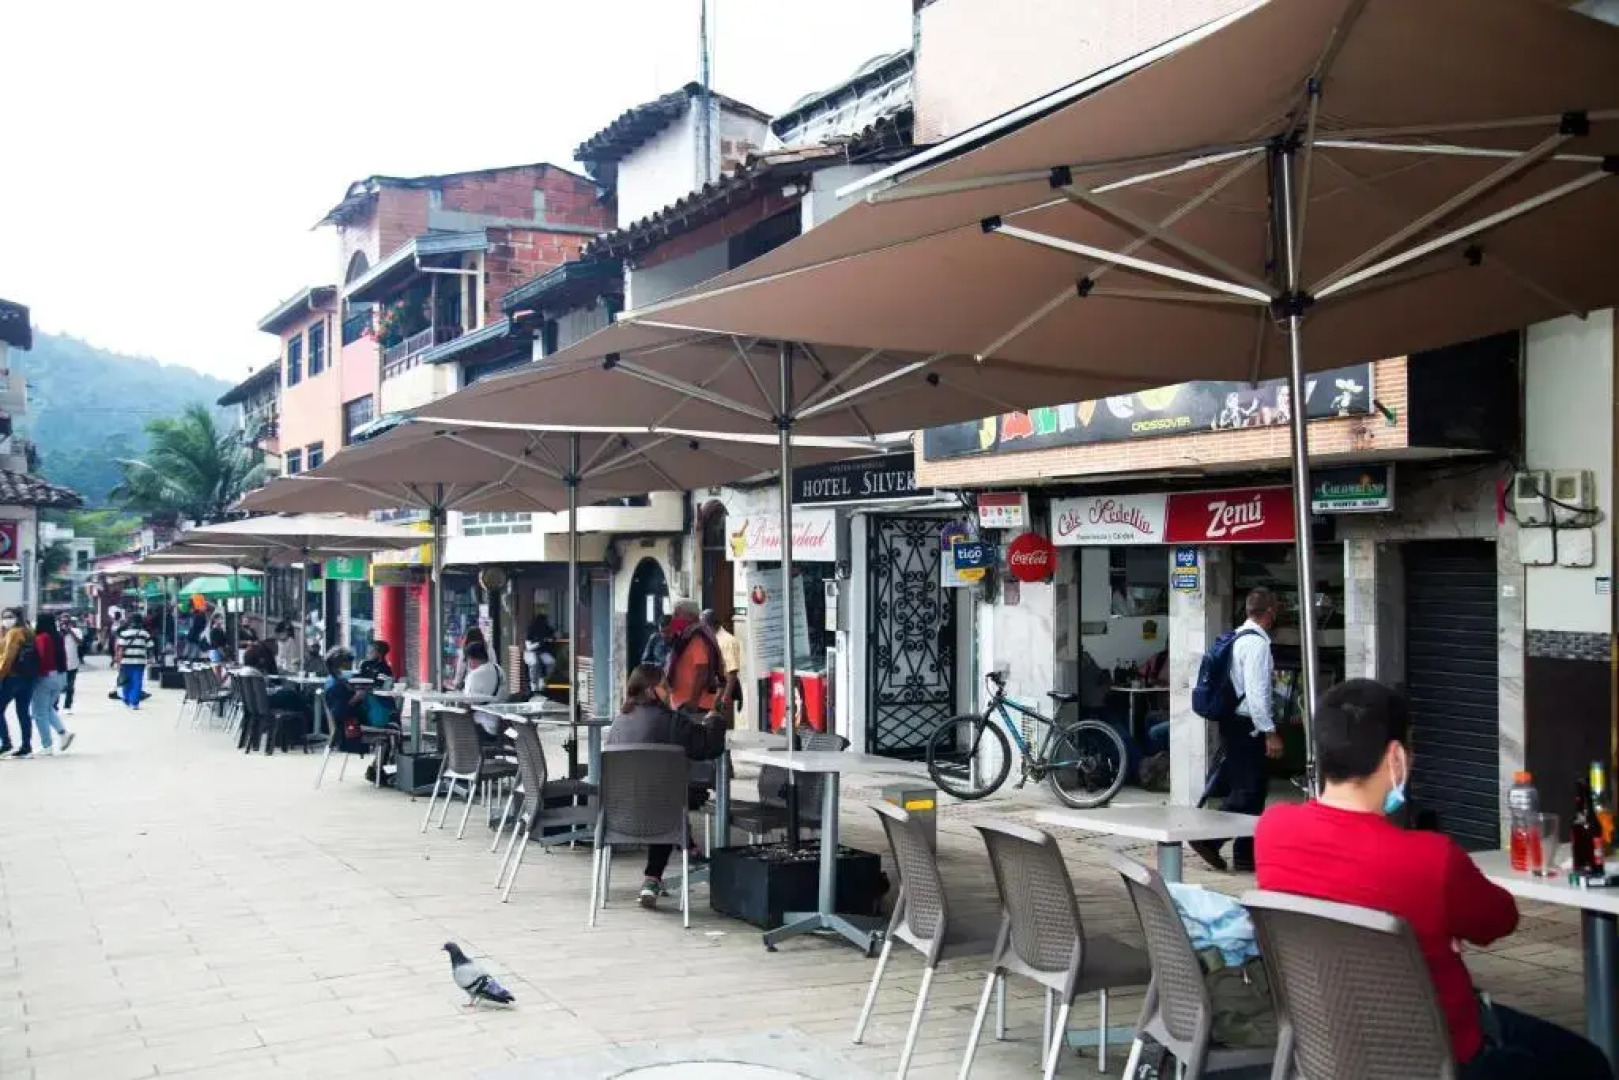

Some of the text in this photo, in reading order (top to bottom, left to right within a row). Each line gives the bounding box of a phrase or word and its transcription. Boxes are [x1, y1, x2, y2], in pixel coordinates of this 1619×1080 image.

[1131, 416, 1190, 432] CROSSOVER
[802, 477, 851, 497] HOTEL
[1058, 508, 1083, 536] Café
[1206, 493, 1262, 537] Zenú
[957, 546, 982, 564] tigo
[1011, 550, 1048, 565] Coca-Cola
